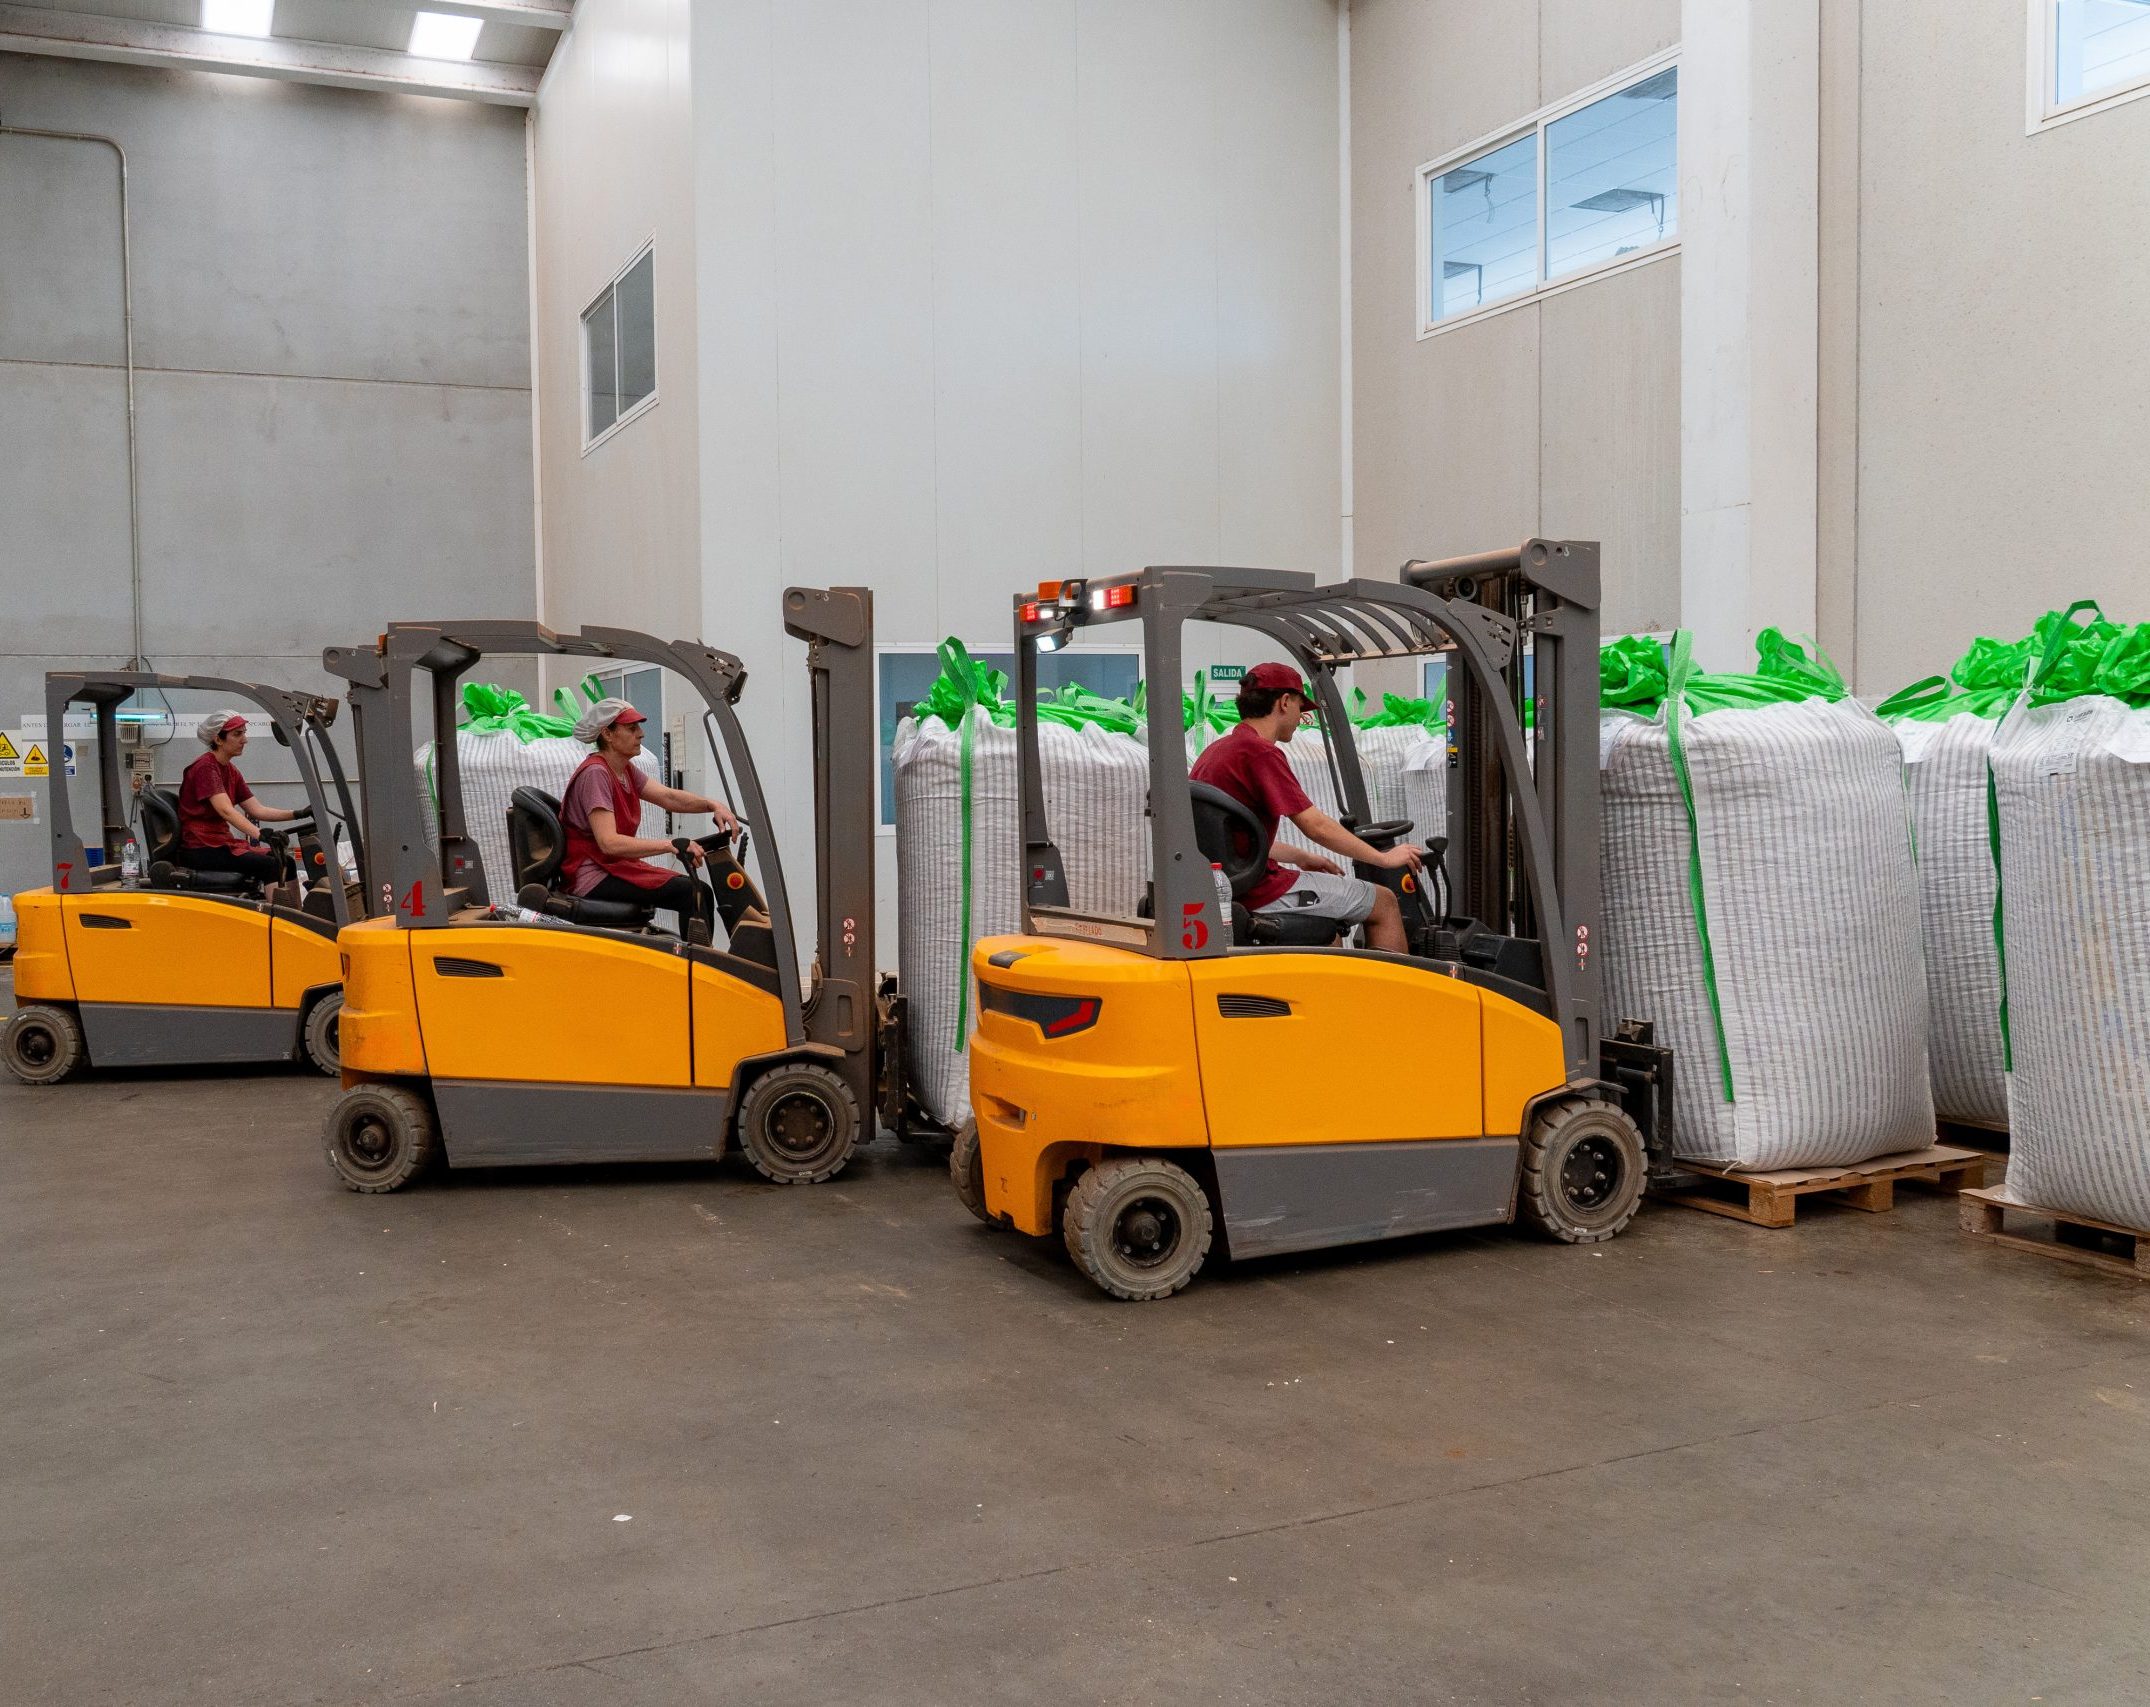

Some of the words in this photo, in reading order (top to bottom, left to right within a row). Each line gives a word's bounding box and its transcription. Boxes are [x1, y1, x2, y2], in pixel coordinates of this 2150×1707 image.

[1213, 668, 1242, 678] SALIDA
[56, 863, 73, 890] 7
[400, 880, 426, 917] 4
[1182, 903, 1208, 950] 5
